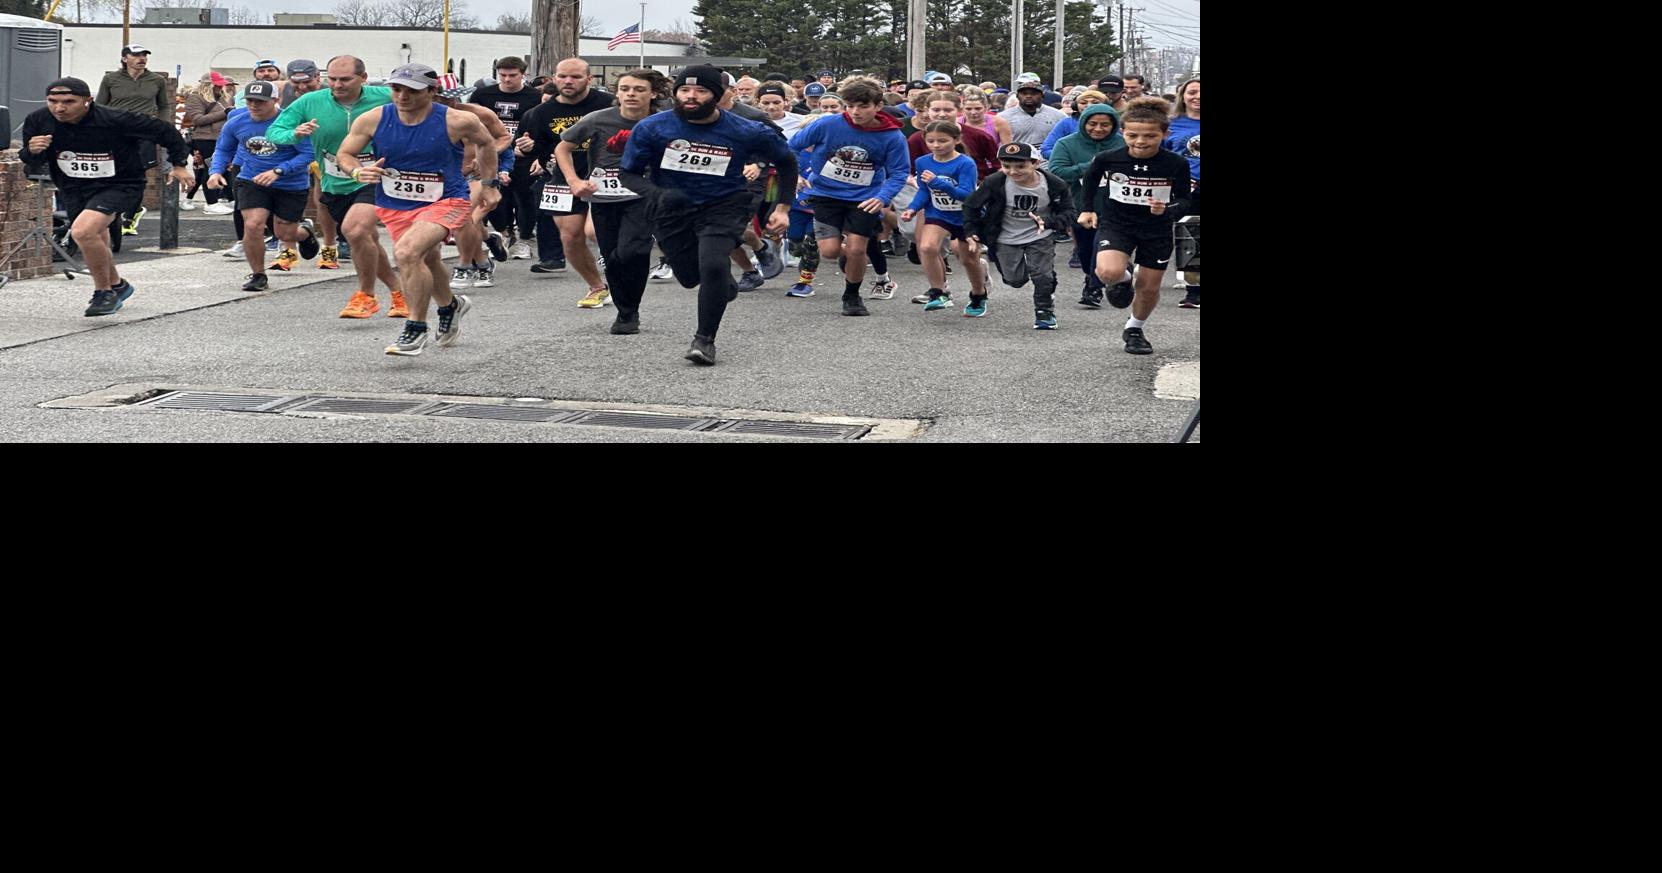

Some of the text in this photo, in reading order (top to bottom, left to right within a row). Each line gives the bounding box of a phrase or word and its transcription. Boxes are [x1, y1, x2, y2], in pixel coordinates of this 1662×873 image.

[679, 154, 712, 166] 269
[71, 162, 99, 171] 365
[834, 168, 860, 178] 355
[394, 182, 424, 193] 236
[1122, 186, 1152, 197] 384
